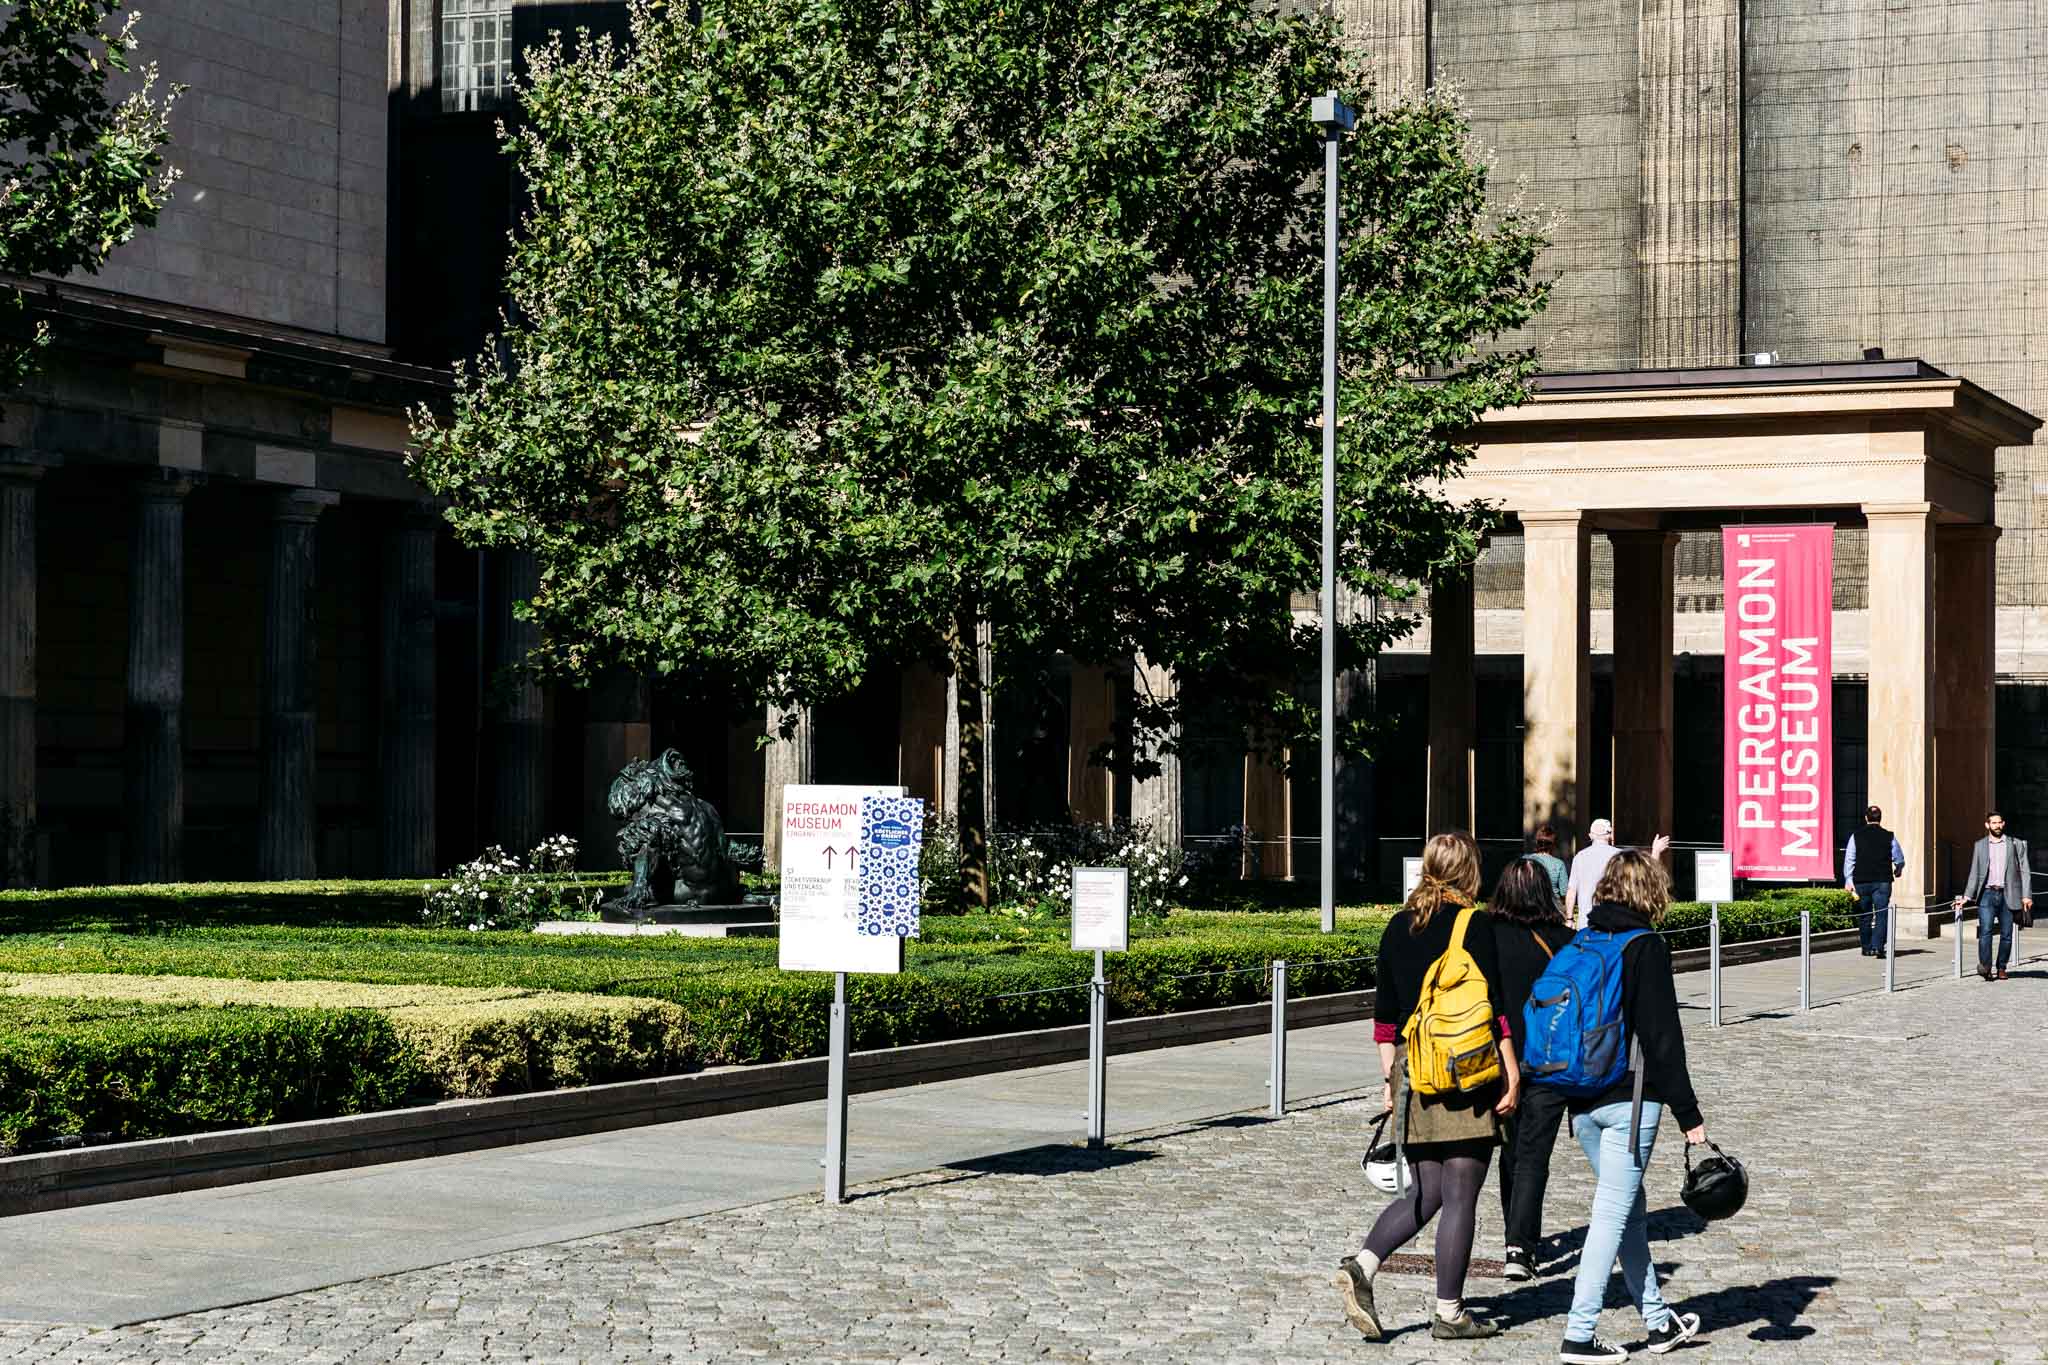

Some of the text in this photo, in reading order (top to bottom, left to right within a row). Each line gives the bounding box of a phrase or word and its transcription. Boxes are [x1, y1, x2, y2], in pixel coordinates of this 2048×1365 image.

[1737, 558, 1776, 829] PERGAMON
[1781, 636, 1819, 858] MUSEUM
[786, 802, 858, 816] PERGAMON
[786, 817, 842, 830] MUSEUM
